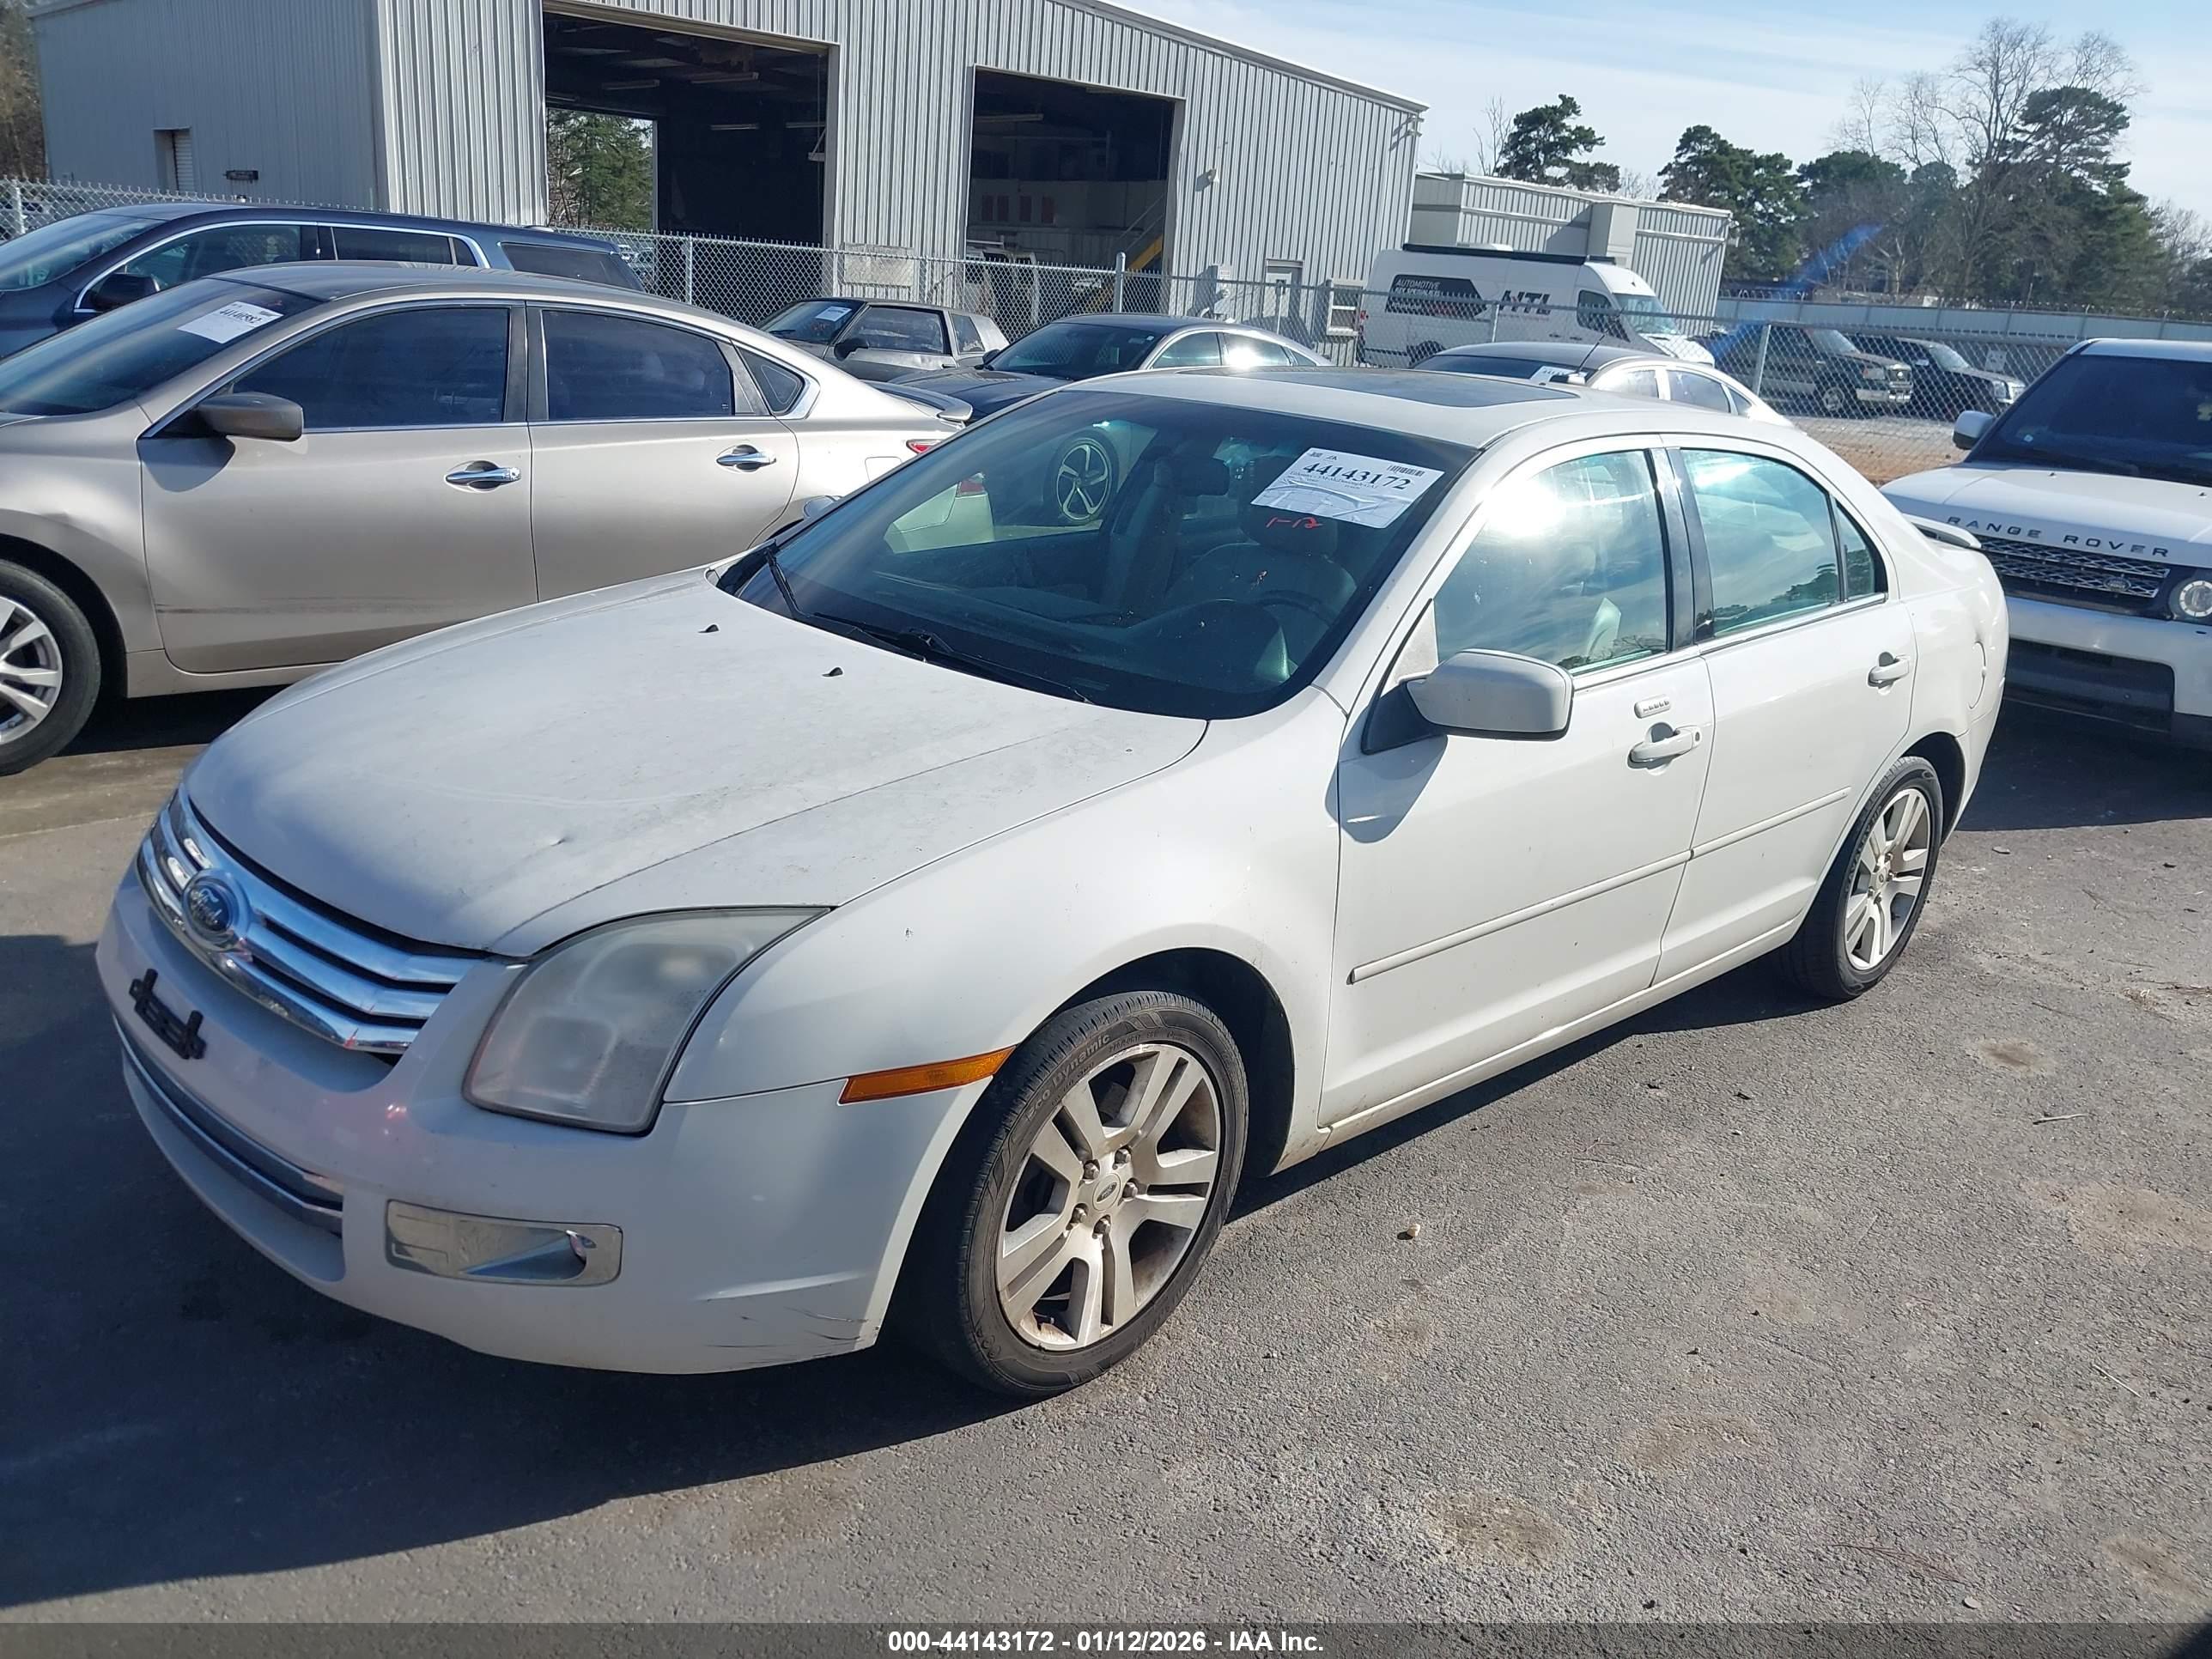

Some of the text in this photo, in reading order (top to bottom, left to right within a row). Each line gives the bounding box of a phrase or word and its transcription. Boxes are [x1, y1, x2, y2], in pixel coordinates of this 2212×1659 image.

[1395, 278, 1441, 290] AUTOMOTIVE
[1303, 462, 1413, 490] 44143172
[1947, 516, 2170, 558] RANGE ROVER
[1052, 1034, 1110, 1089] Dynamic
